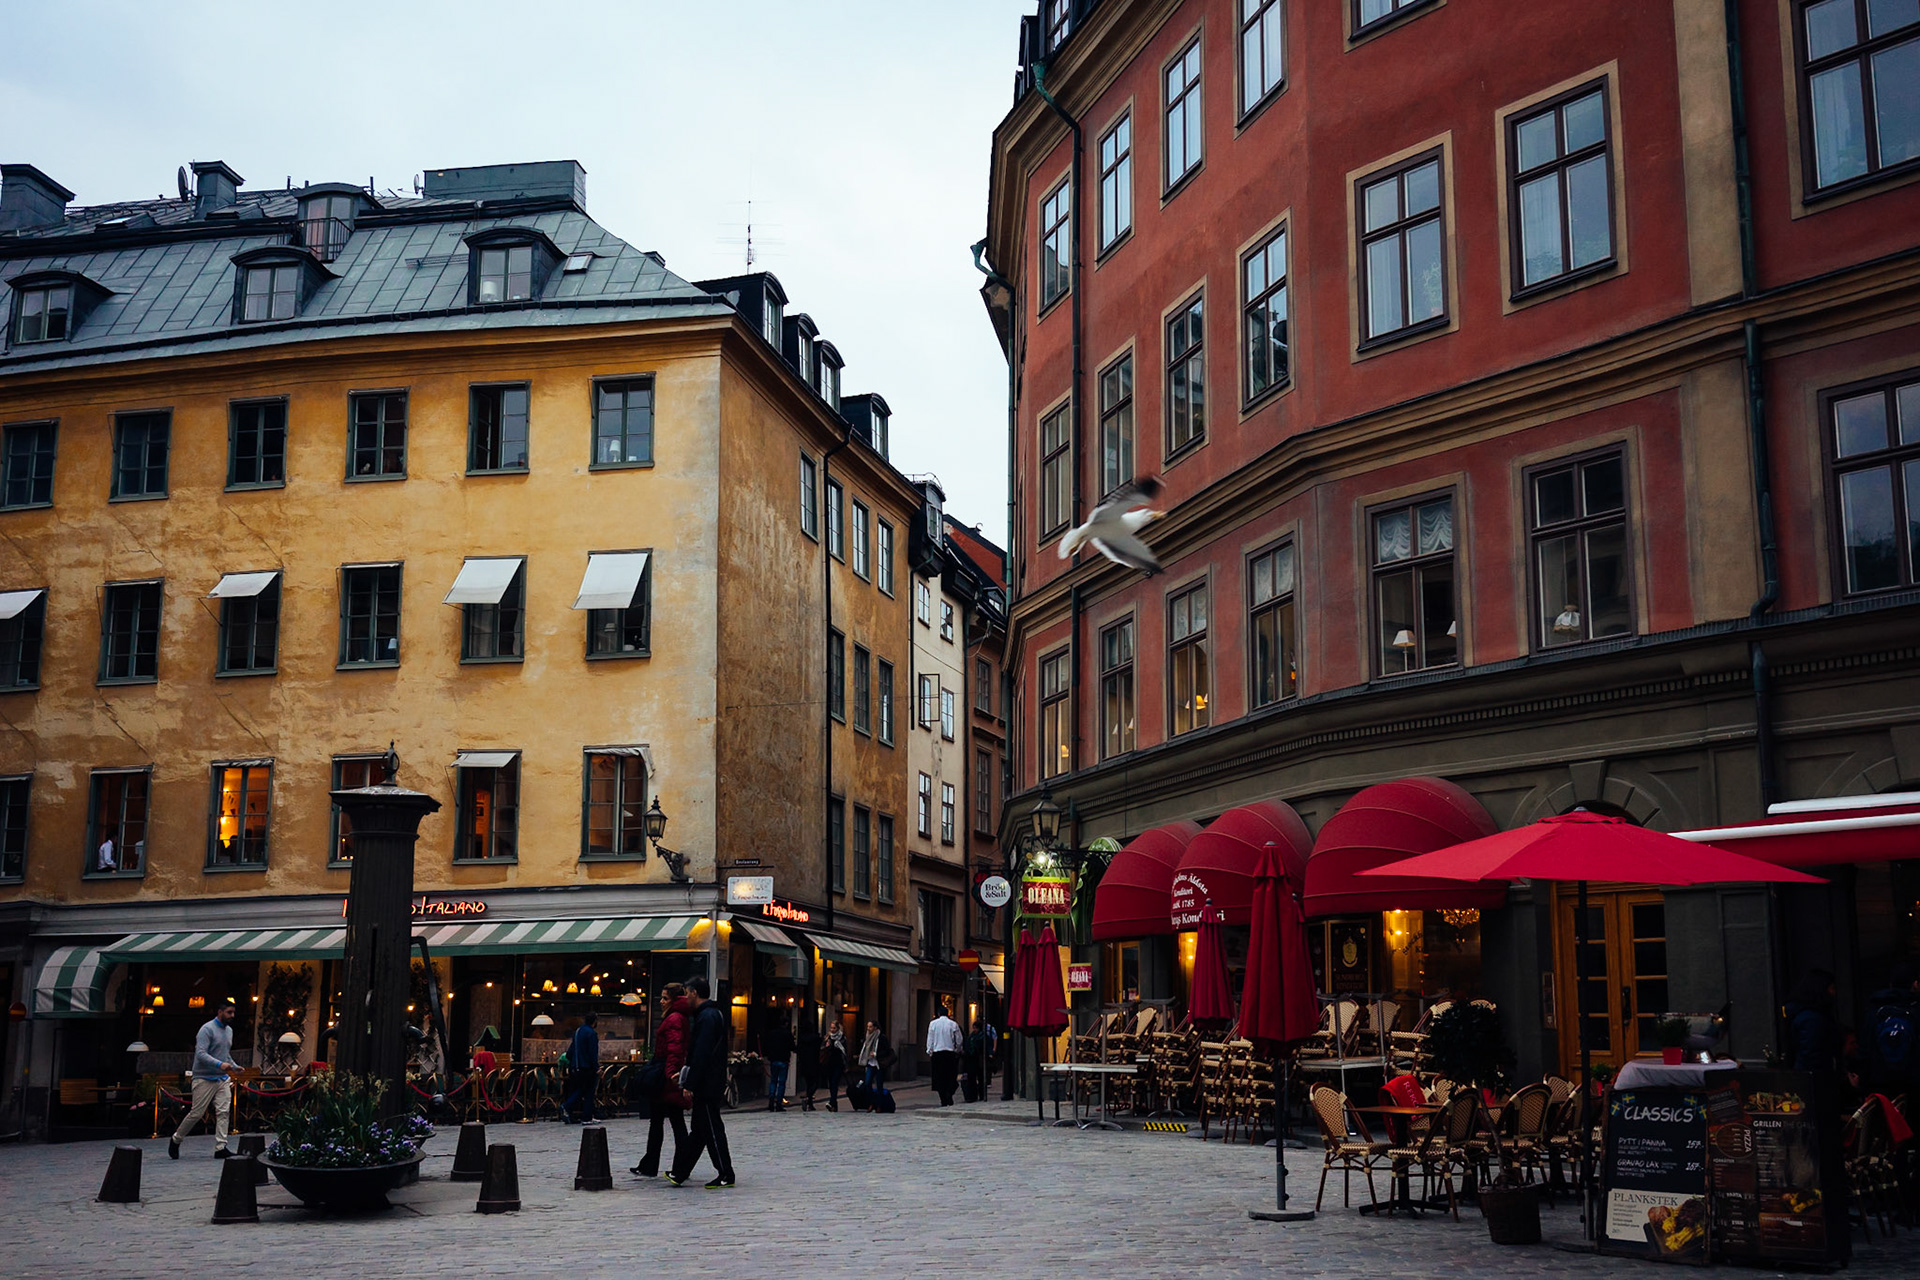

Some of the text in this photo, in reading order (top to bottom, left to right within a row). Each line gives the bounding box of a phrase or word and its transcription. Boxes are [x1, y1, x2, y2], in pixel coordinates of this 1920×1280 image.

[984, 883, 1006, 891] Bröd
[984, 890, 1007, 899] &Salt
[1623, 1105, 1694, 1124] CLASSICS
[1753, 1120, 1782, 1128] GRILLEN
[1743, 1129, 1753, 1153] PIZZA
[1645, 1160, 1660, 1169] LAX
[1613, 1192, 1679, 1207] PLANKSTEK
